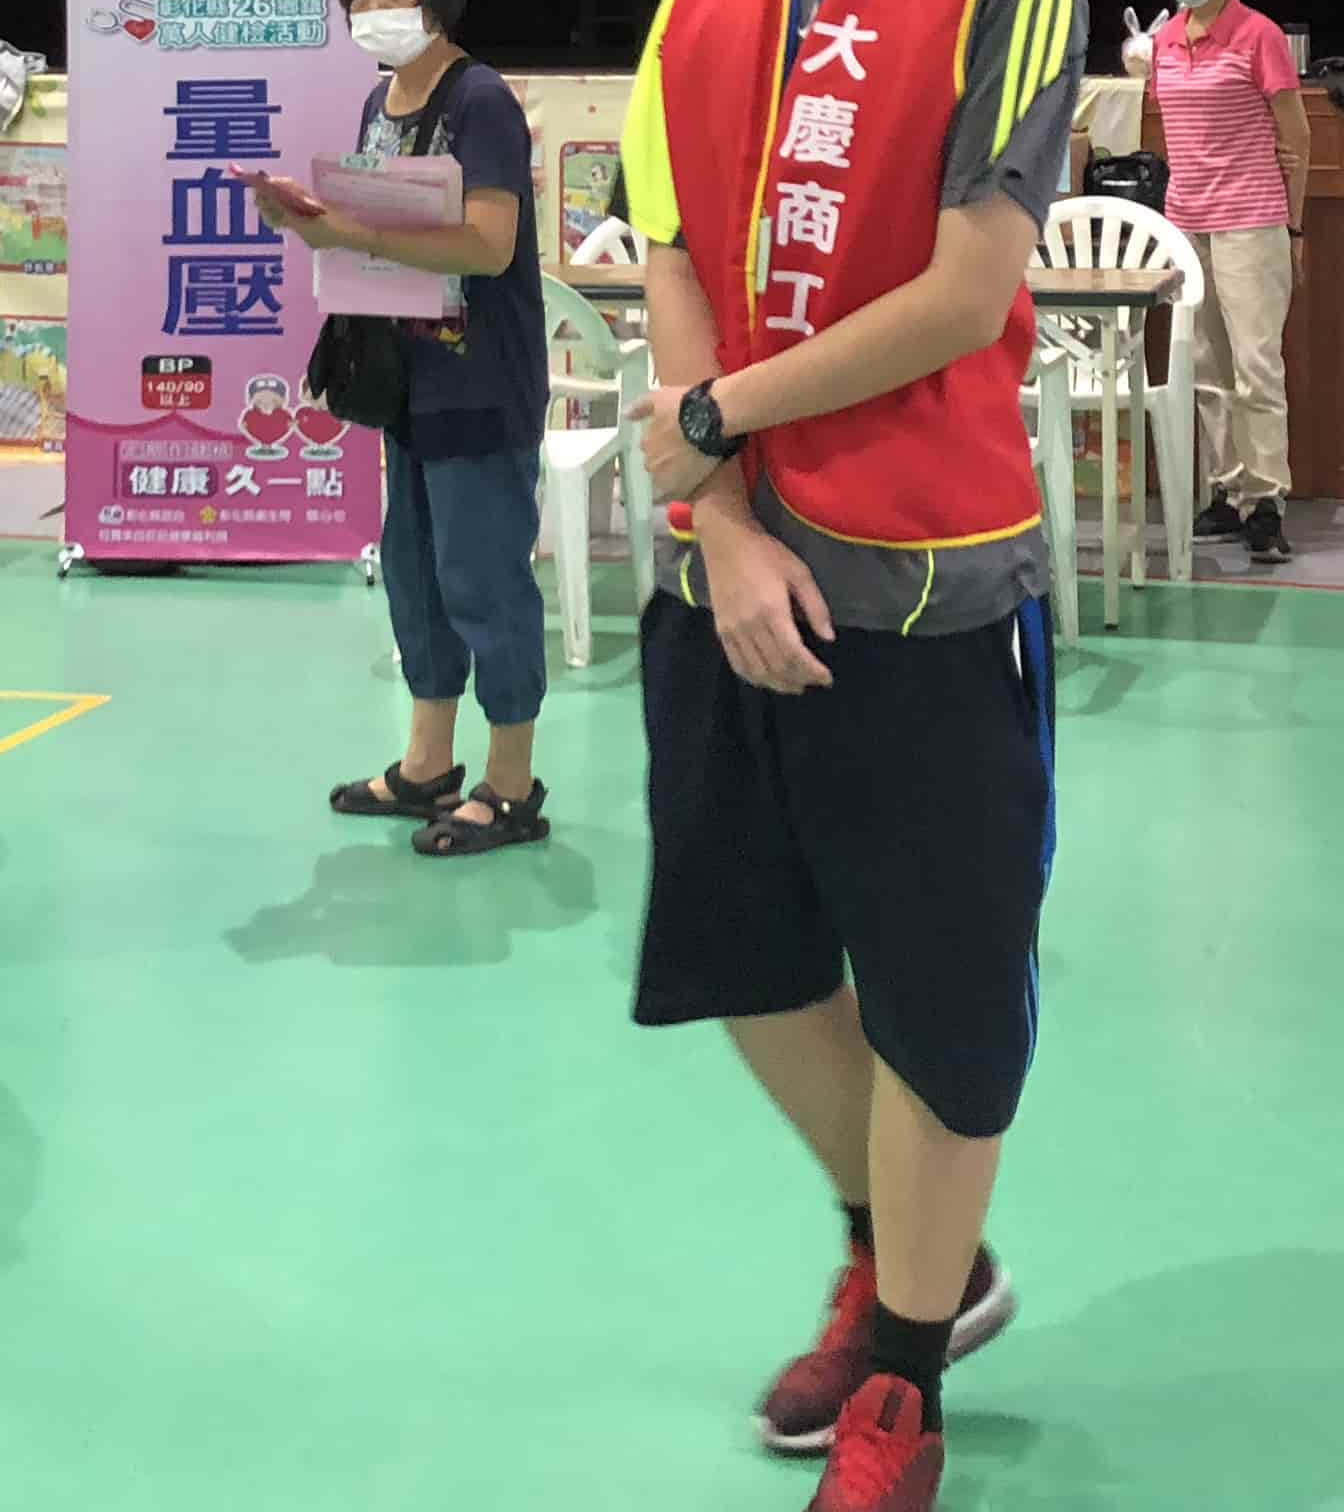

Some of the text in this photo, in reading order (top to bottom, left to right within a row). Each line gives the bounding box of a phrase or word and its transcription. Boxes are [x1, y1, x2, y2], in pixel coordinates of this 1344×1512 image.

[161, 79, 285, 337] 量血壓
[765, 13, 880, 338] 大慶商工
[146, 380, 206, 394] 140/90
[159, 358, 194, 374] BP
